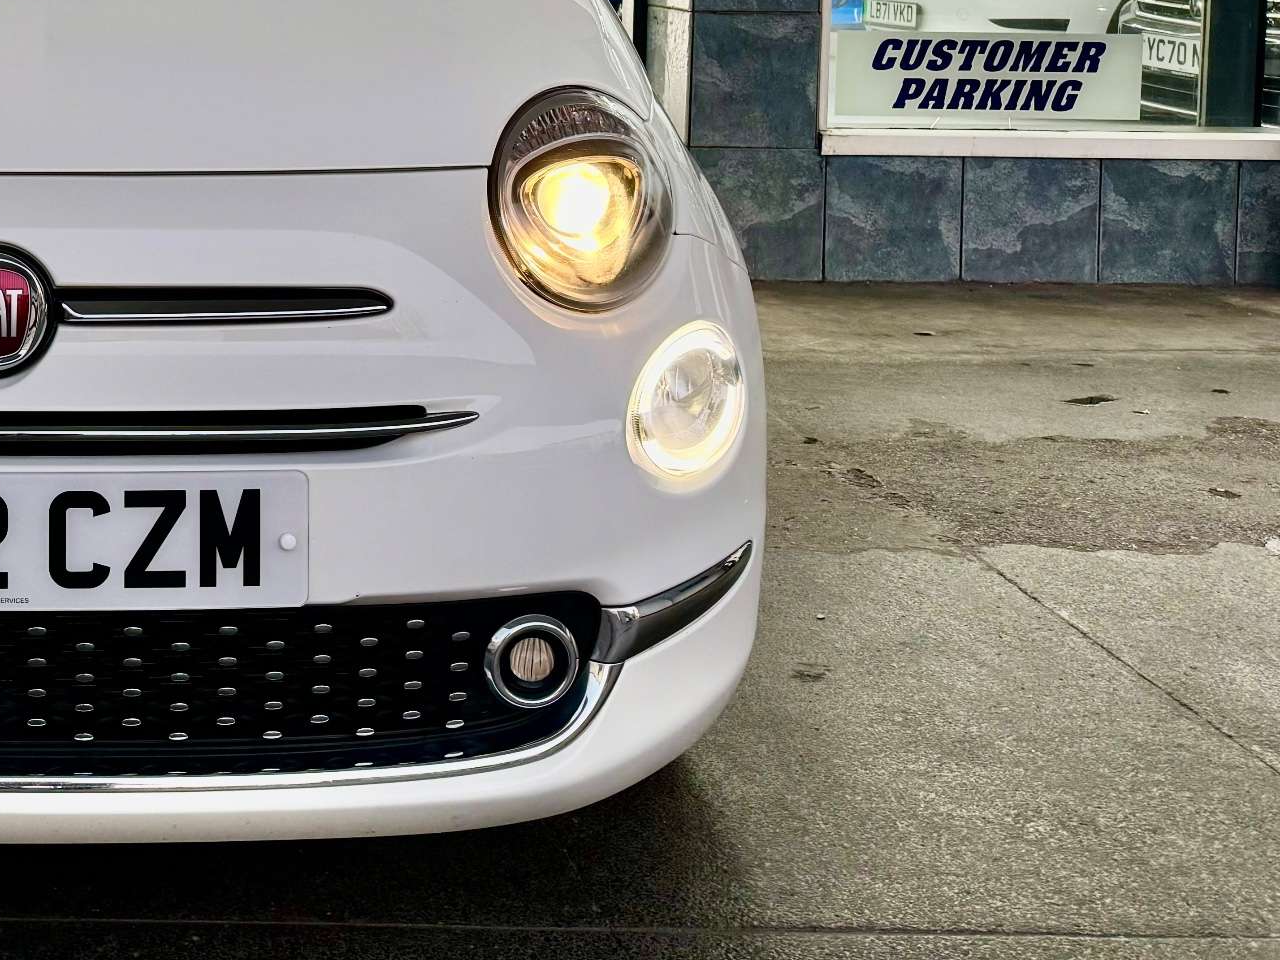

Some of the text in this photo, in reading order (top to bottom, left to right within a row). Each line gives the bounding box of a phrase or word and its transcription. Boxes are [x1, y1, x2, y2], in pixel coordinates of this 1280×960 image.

[870, 0, 913, 23] LB71 VKD
[871, 38, 1107, 74] CUSTOMER
[1147, 36, 1187, 66] YC70
[891, 78, 1084, 112] PARKING
[48, 487, 261, 591] CZM
